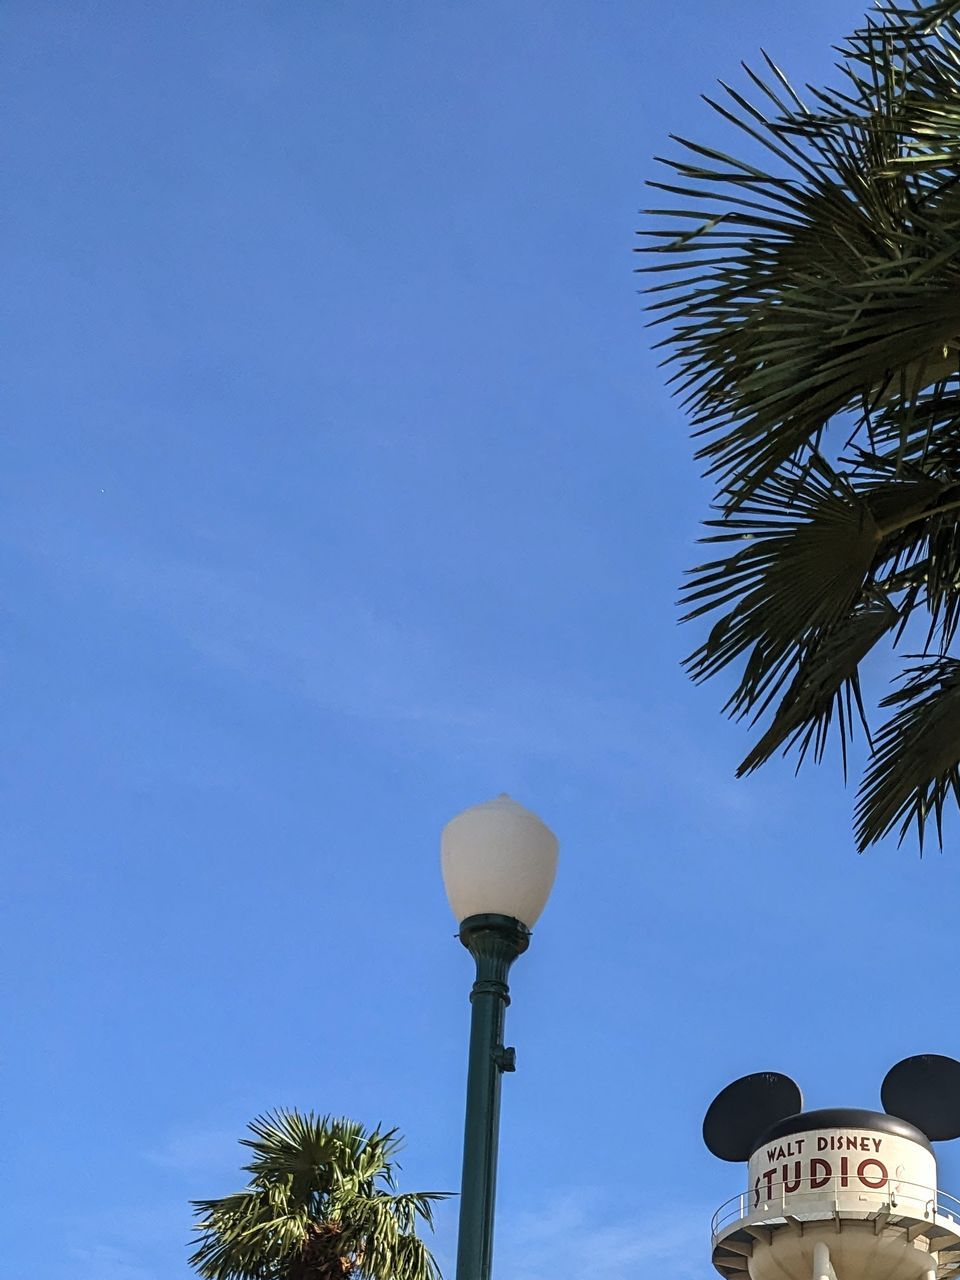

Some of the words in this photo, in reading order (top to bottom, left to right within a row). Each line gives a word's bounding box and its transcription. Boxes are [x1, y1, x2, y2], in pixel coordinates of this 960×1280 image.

[767, 1139, 804, 1163] WALT
[817, 1136, 882, 1153] DISNEY
[754, 1157, 905, 1208] STUDIO
